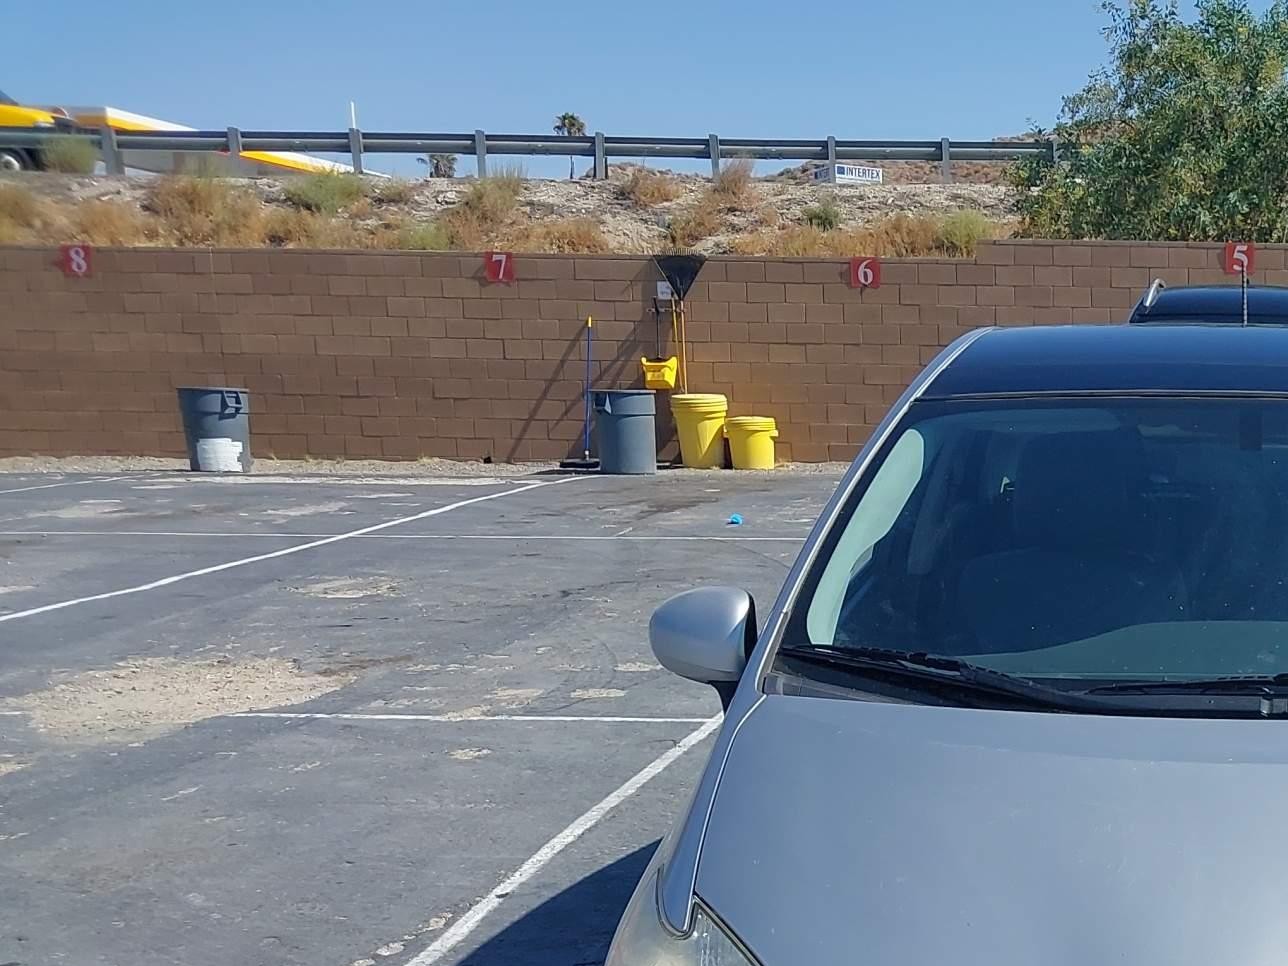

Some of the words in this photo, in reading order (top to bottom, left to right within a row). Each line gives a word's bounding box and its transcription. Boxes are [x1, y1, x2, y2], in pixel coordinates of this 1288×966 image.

[846, 166, 881, 180] INTERTEX
[69, 247, 88, 273] 8
[491, 254, 507, 280] 7
[1232, 245, 1249, 272] 5
[857, 259, 874, 286] 6
